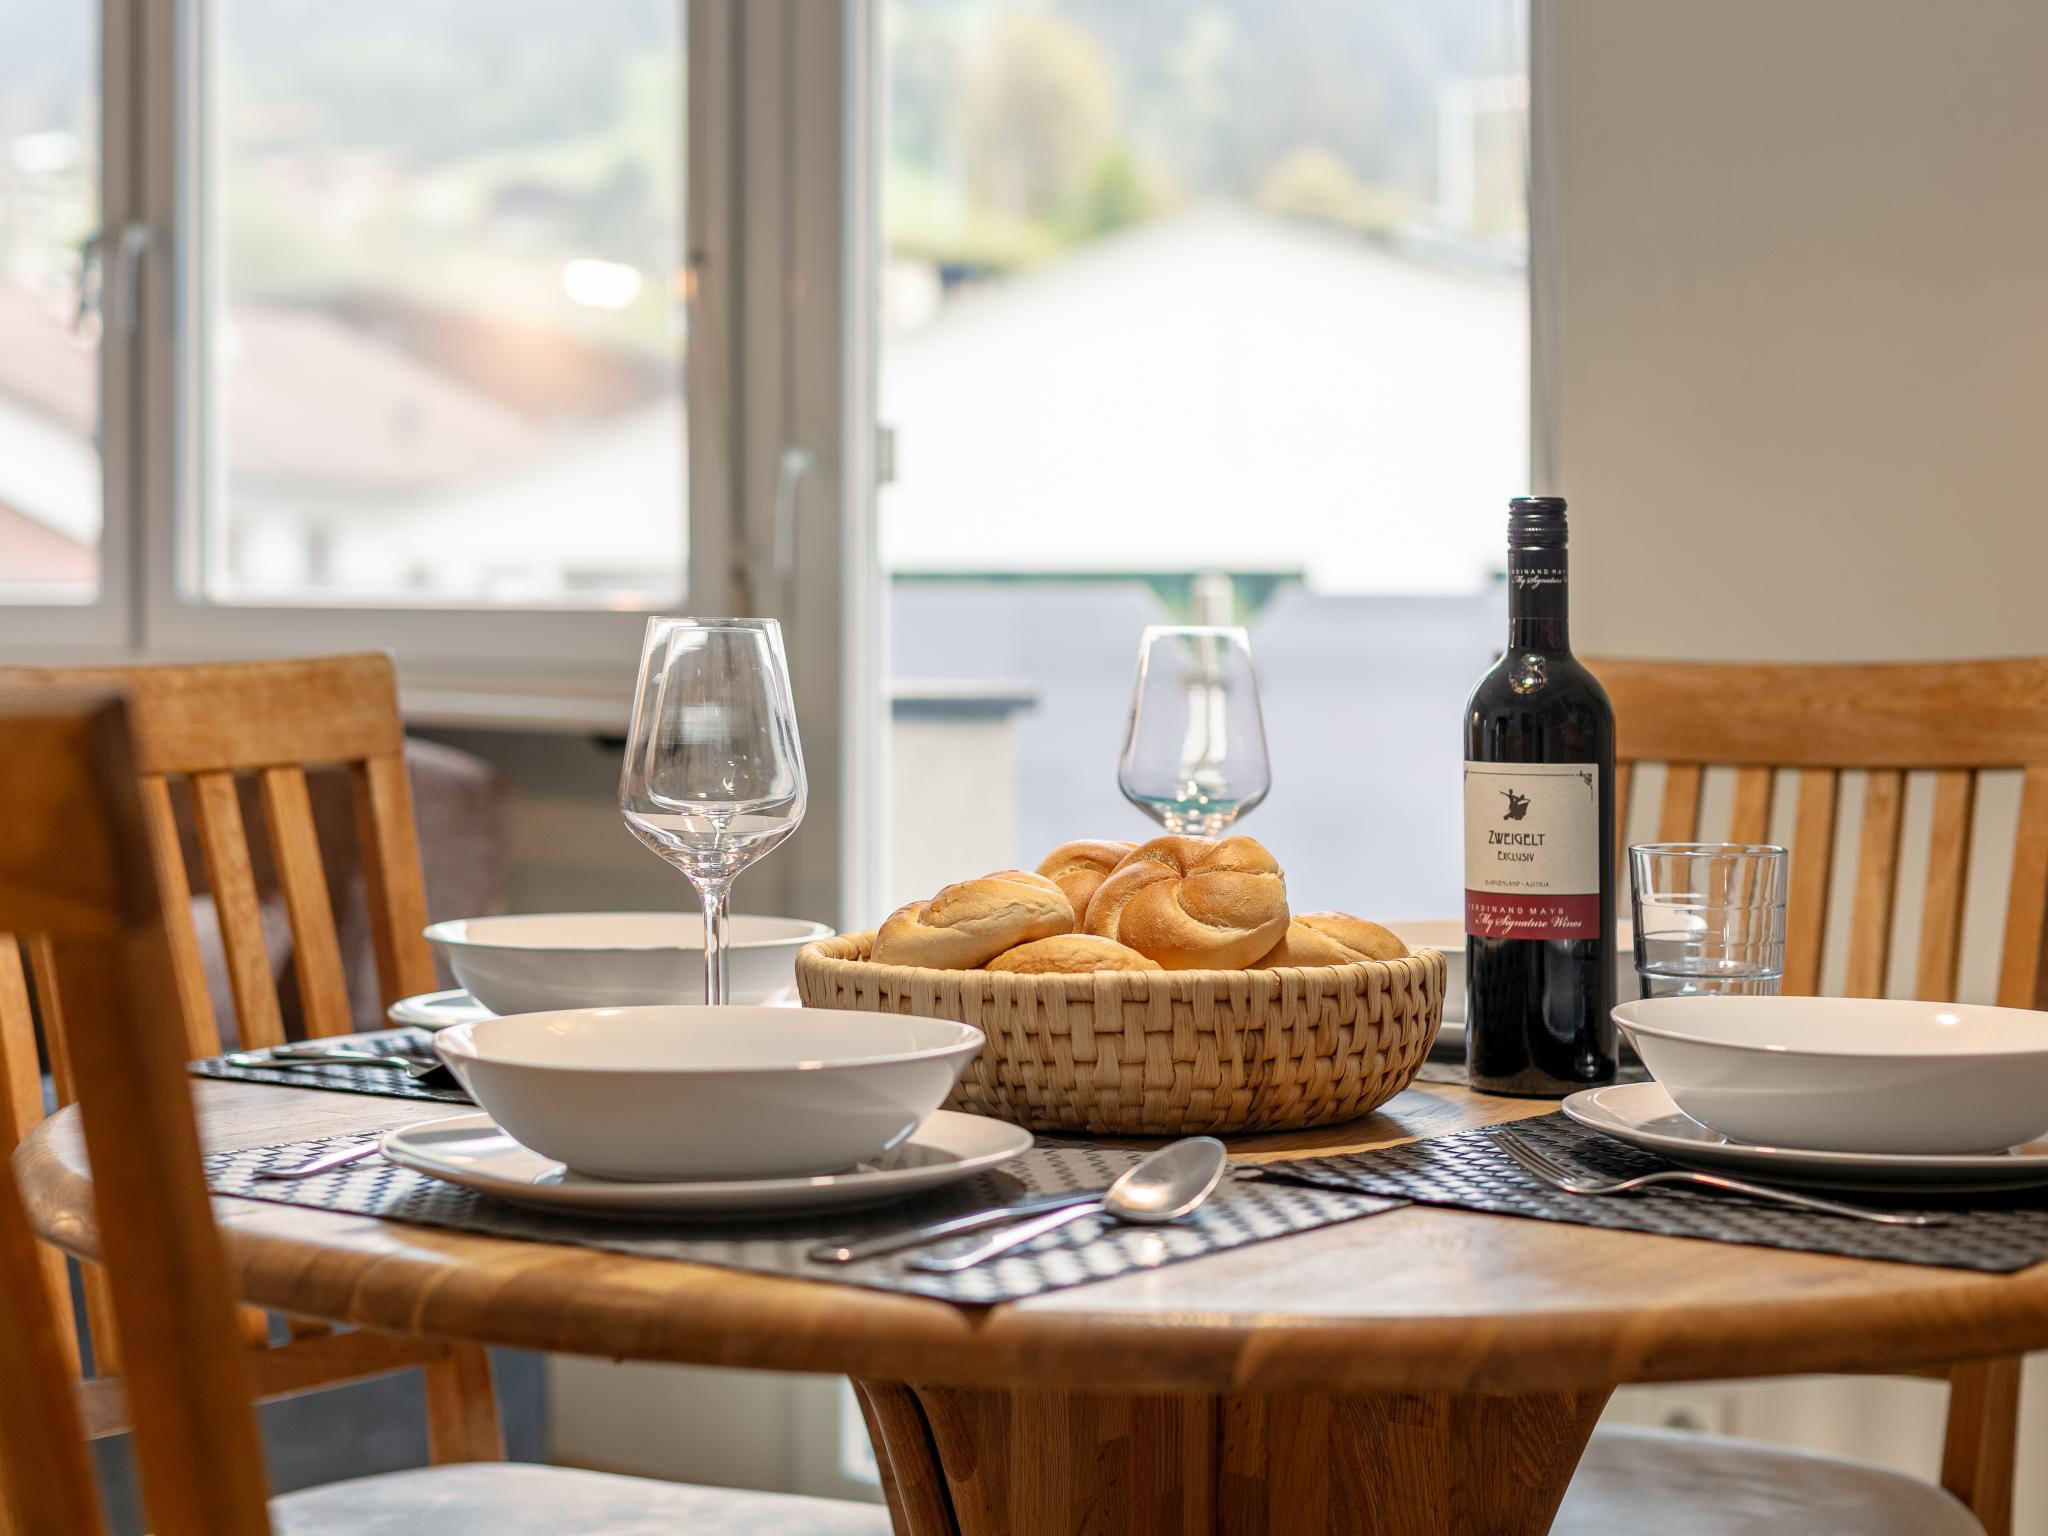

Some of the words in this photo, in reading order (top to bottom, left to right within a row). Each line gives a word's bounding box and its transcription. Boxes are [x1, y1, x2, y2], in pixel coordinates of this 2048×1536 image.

[1488, 829, 1546, 847] ZWEIGELT
[1497, 850, 1535, 863] EXCLUSIV
[1529, 907, 1565, 916] MAYR
[1475, 912, 1493, 934] My
[1494, 914, 1548, 935] Signature
[1551, 914, 1583, 929] Wines
